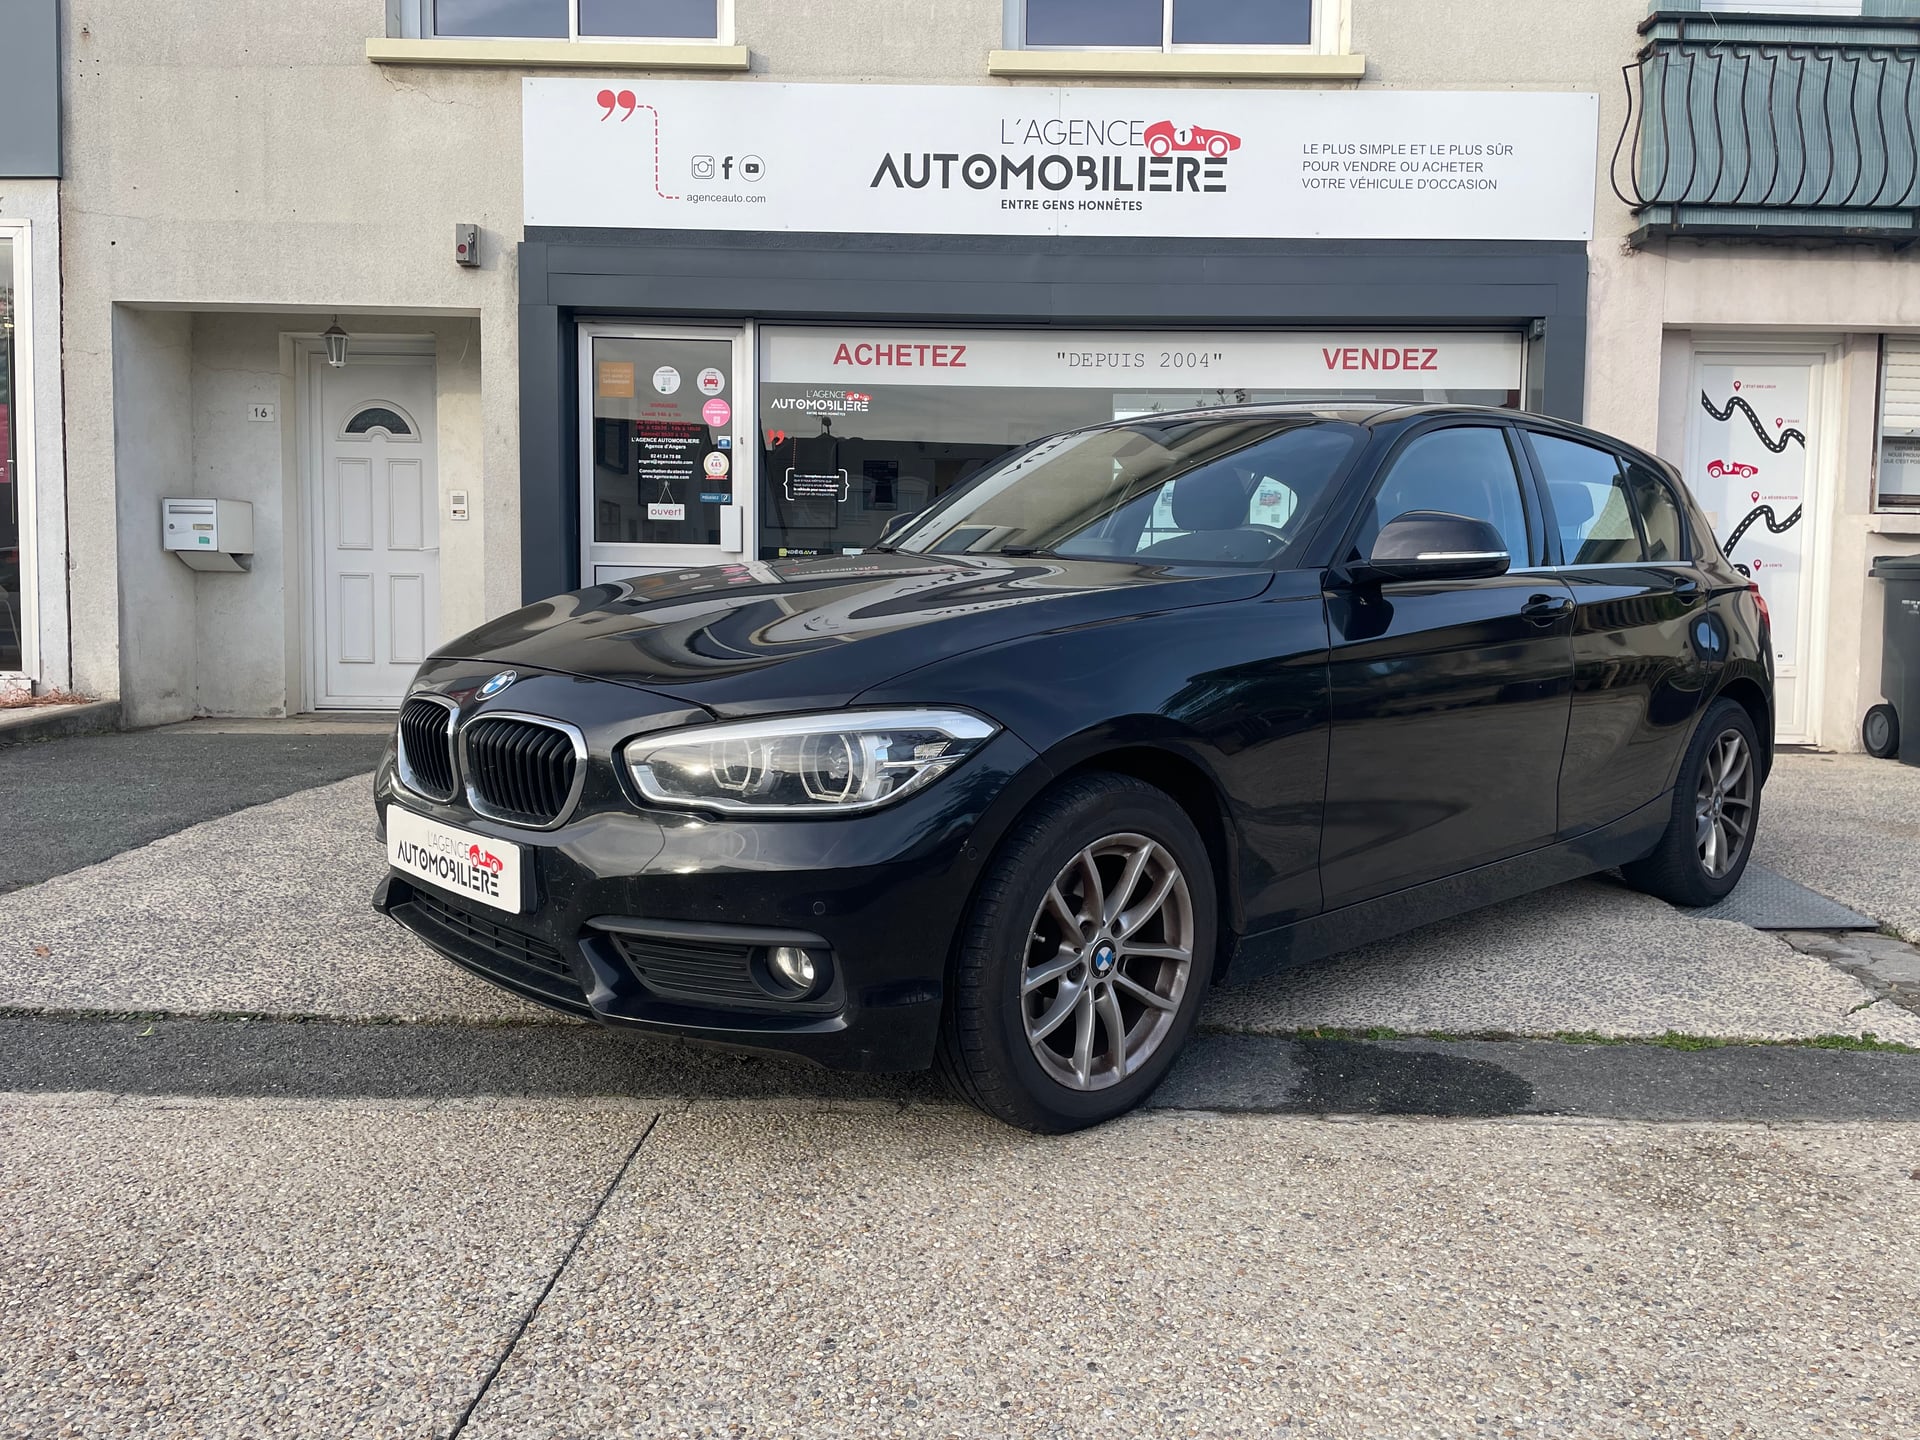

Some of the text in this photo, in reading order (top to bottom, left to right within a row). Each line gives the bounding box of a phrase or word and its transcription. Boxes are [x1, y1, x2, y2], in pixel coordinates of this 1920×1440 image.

[1001, 118, 1145, 147] L'AGENCE
[1303, 142, 1513, 156] LE PLUS SIMPLE ET LE PLUS SÛR
[1302, 161, 1483, 173] POUR VENDRE OU ACHETER
[1302, 176, 1498, 190] VOTRE VÉHICULE D'OCCASION
[686, 194, 767, 204] agenceauto.com
[1001, 197, 1143, 211] ENTRE GENS HONNÊTES
[833, 343, 967, 367] ACHETEZ
[1322, 348, 1438, 370] VENDEZ
[806, 390, 846, 399] L'AGENCE
[255, 407, 267, 418] 16
[650, 508, 681, 516] ouvert
